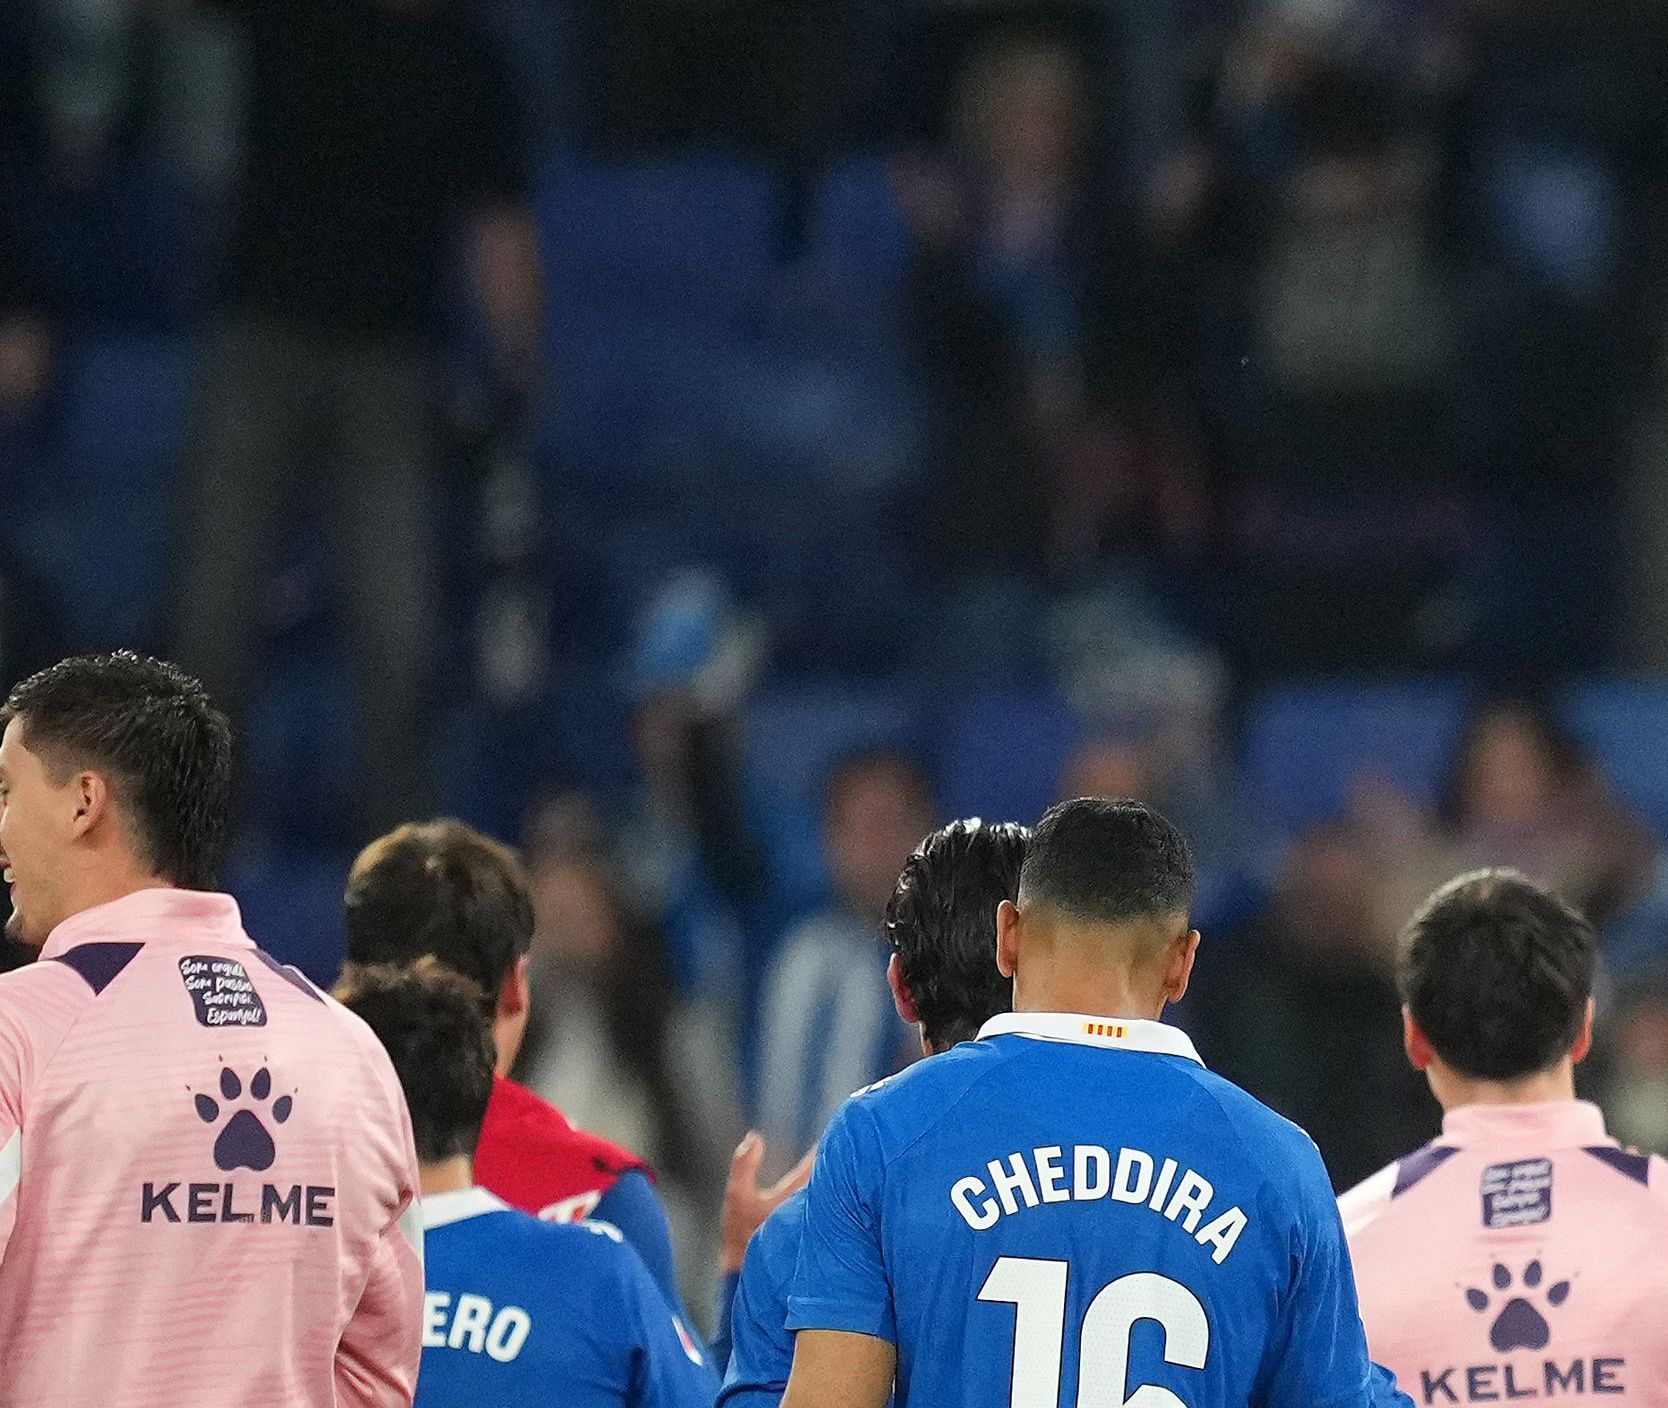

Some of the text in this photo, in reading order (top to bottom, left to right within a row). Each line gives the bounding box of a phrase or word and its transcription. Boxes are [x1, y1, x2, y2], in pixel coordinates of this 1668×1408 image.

[141, 1182, 335, 1227] KELME
[949, 1144, 1248, 1265] CHEDDIRA
[1421, 1357, 1626, 1404] KELME
